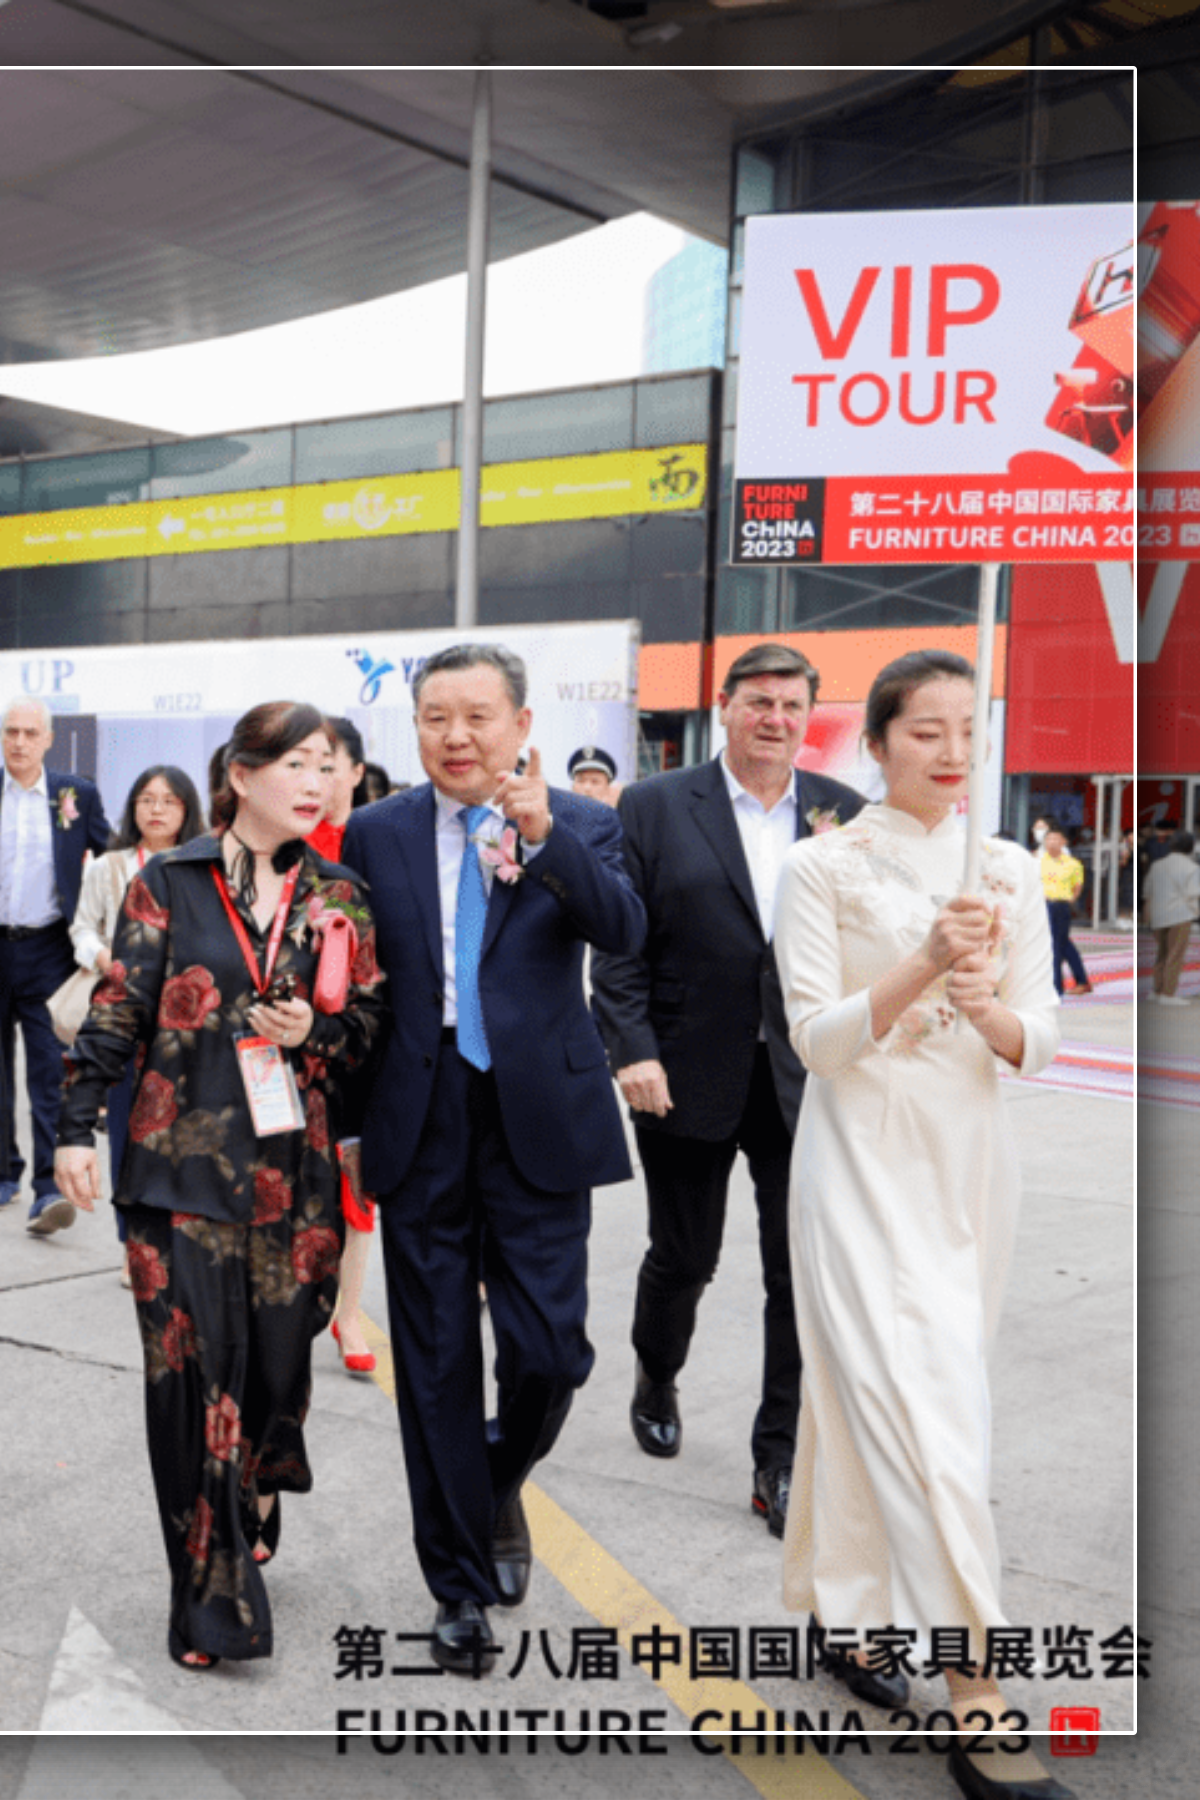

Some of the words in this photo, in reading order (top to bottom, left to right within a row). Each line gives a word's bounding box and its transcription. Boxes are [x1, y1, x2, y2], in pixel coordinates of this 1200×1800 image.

[794, 263, 1002, 361] VIP
[791, 369, 998, 428] TOUR
[743, 485, 808, 502] FURNI
[743, 503, 796, 520] TURE
[849, 525, 1005, 550] FURNITURE
[1012, 524, 1097, 548] CHINA
[1103, 524, 1172, 547] 2023
[741, 540, 796, 557] 2023
[19, 659, 75, 694] UP
[556, 682, 623, 701] W1E22
[153, 692, 202, 712] W1E22
